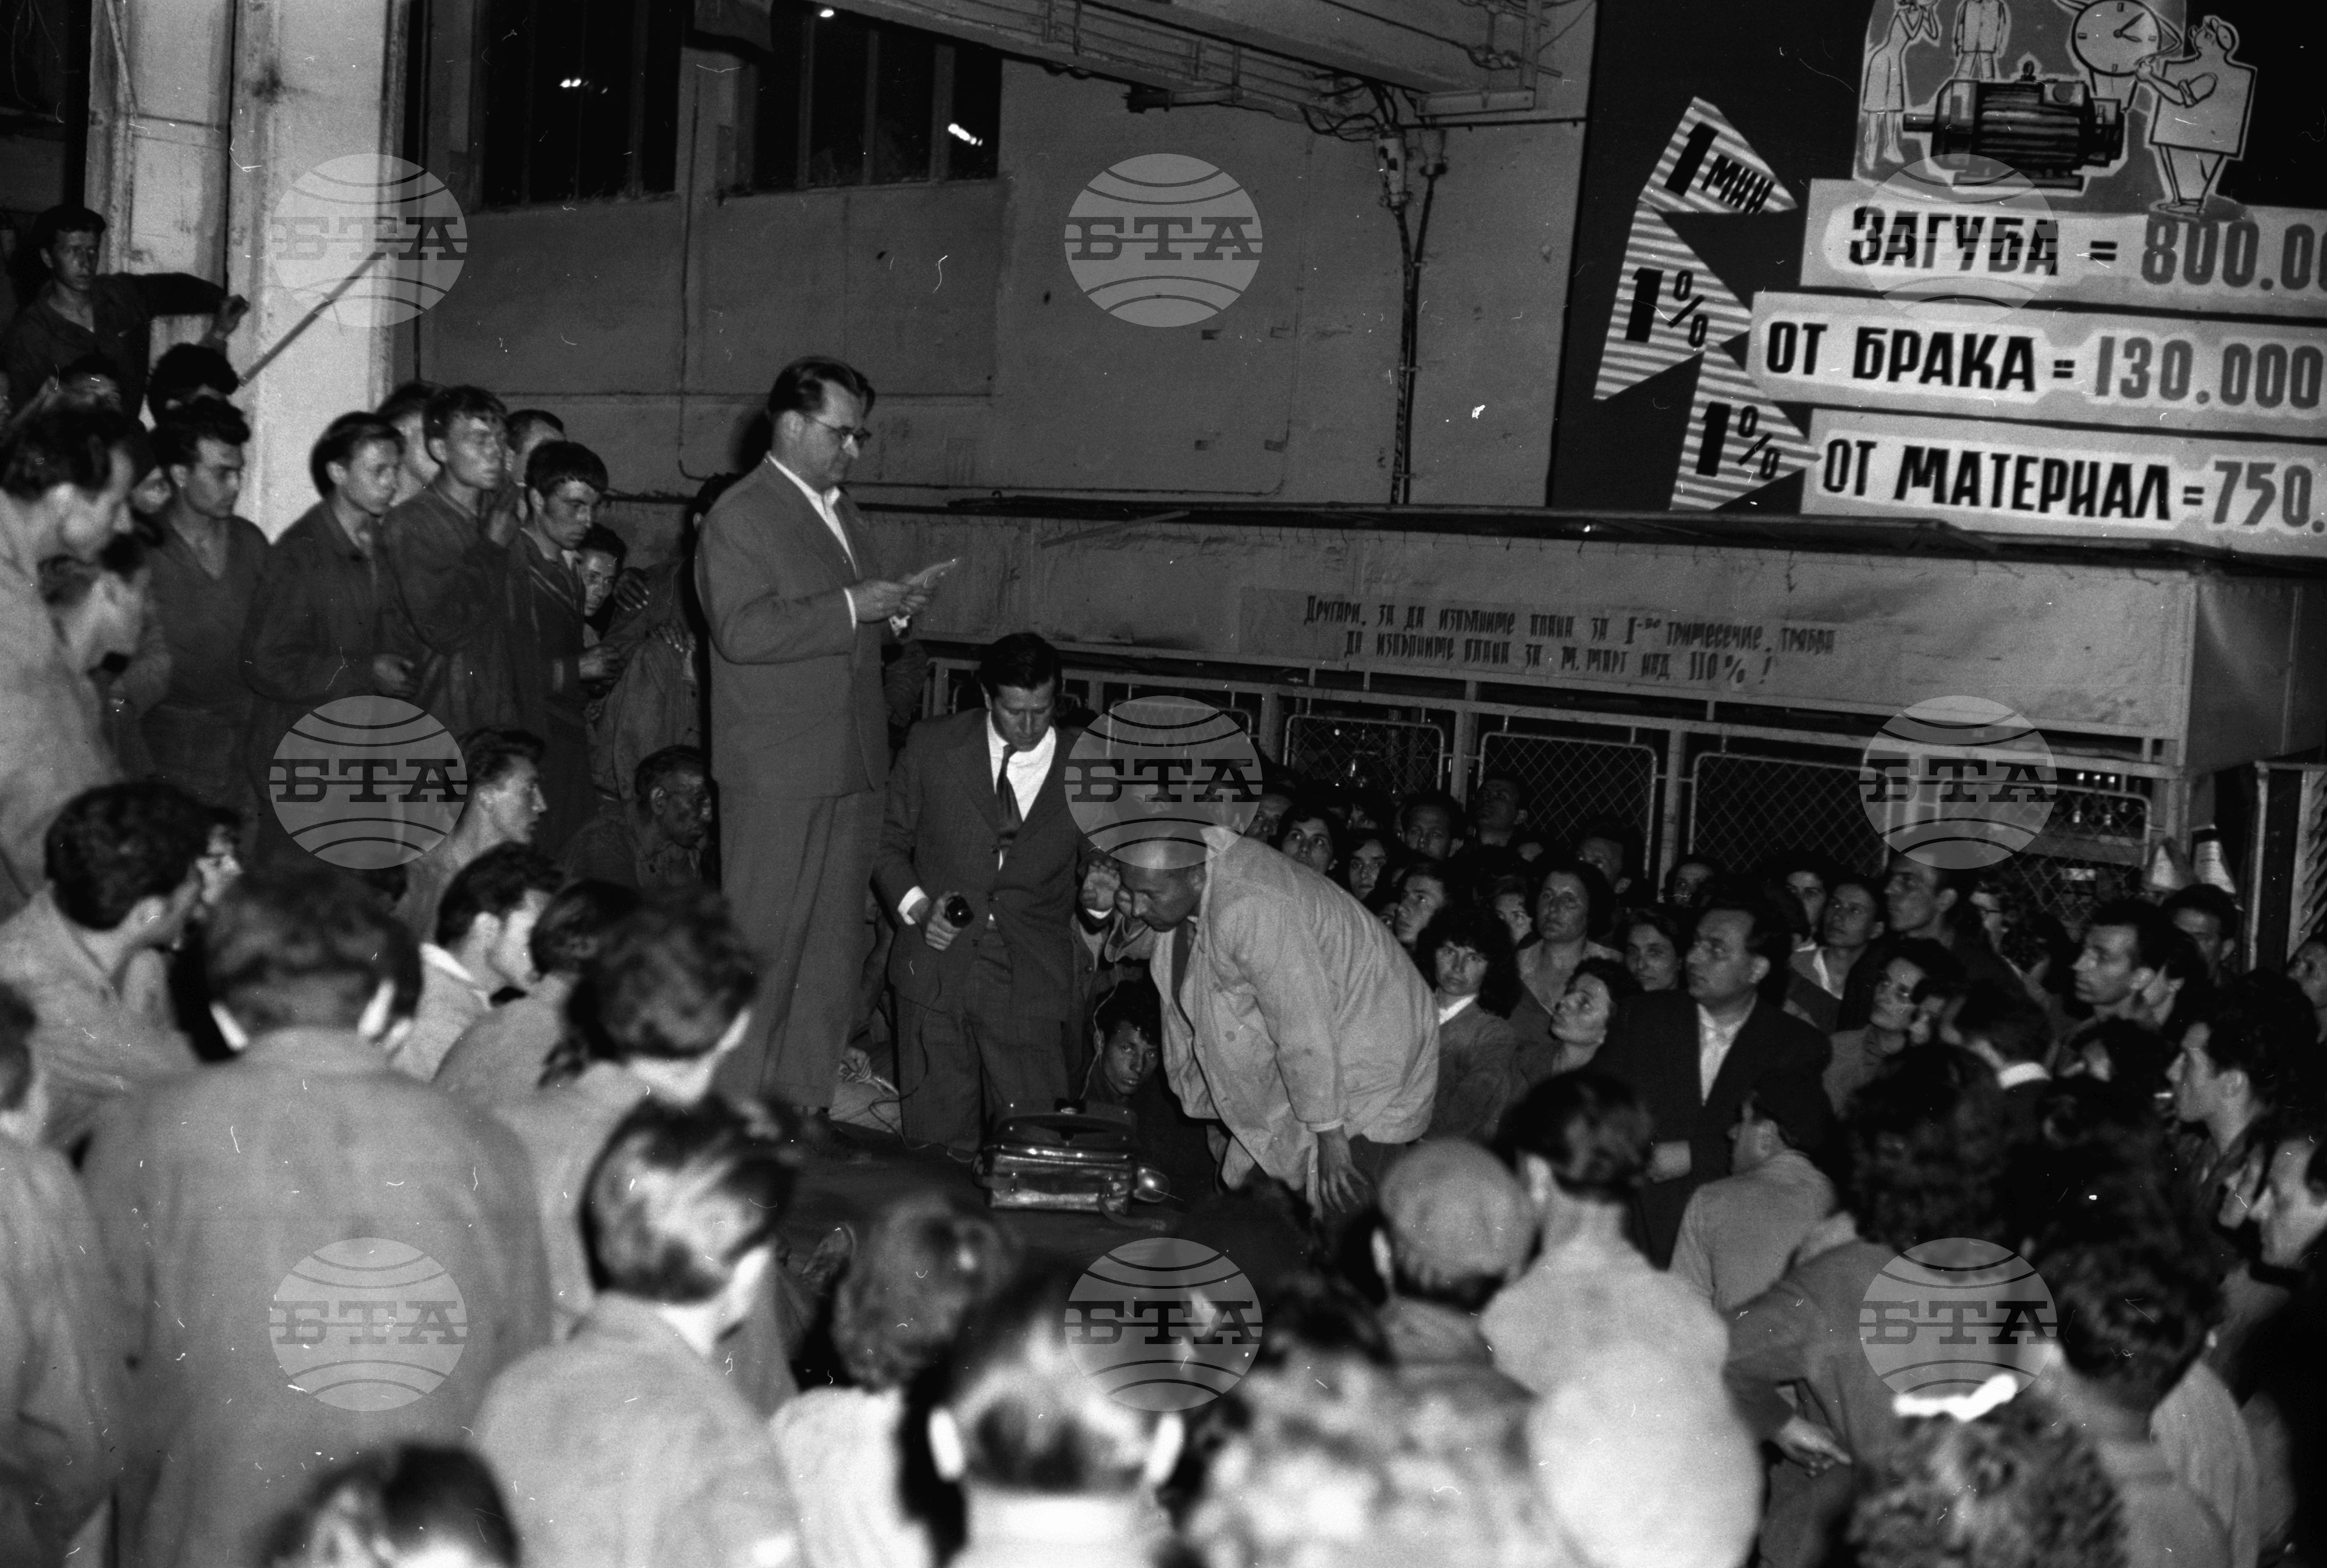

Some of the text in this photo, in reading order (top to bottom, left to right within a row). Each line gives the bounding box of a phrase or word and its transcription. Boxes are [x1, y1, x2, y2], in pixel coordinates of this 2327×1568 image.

[1664, 122, 1719, 196] 1
[1849, 206, 2058, 276] ЗАГУБА
[2141, 218, 2327, 292] 800.0
[1766, 321, 1828, 375] ОТ
[1852, 326, 2036, 393] БРАКА
[2095, 336, 2324, 409] 130.000
[1822, 438, 1878, 497] ОТ
[1892, 444, 2171, 521] МАТЕРИАЛ
